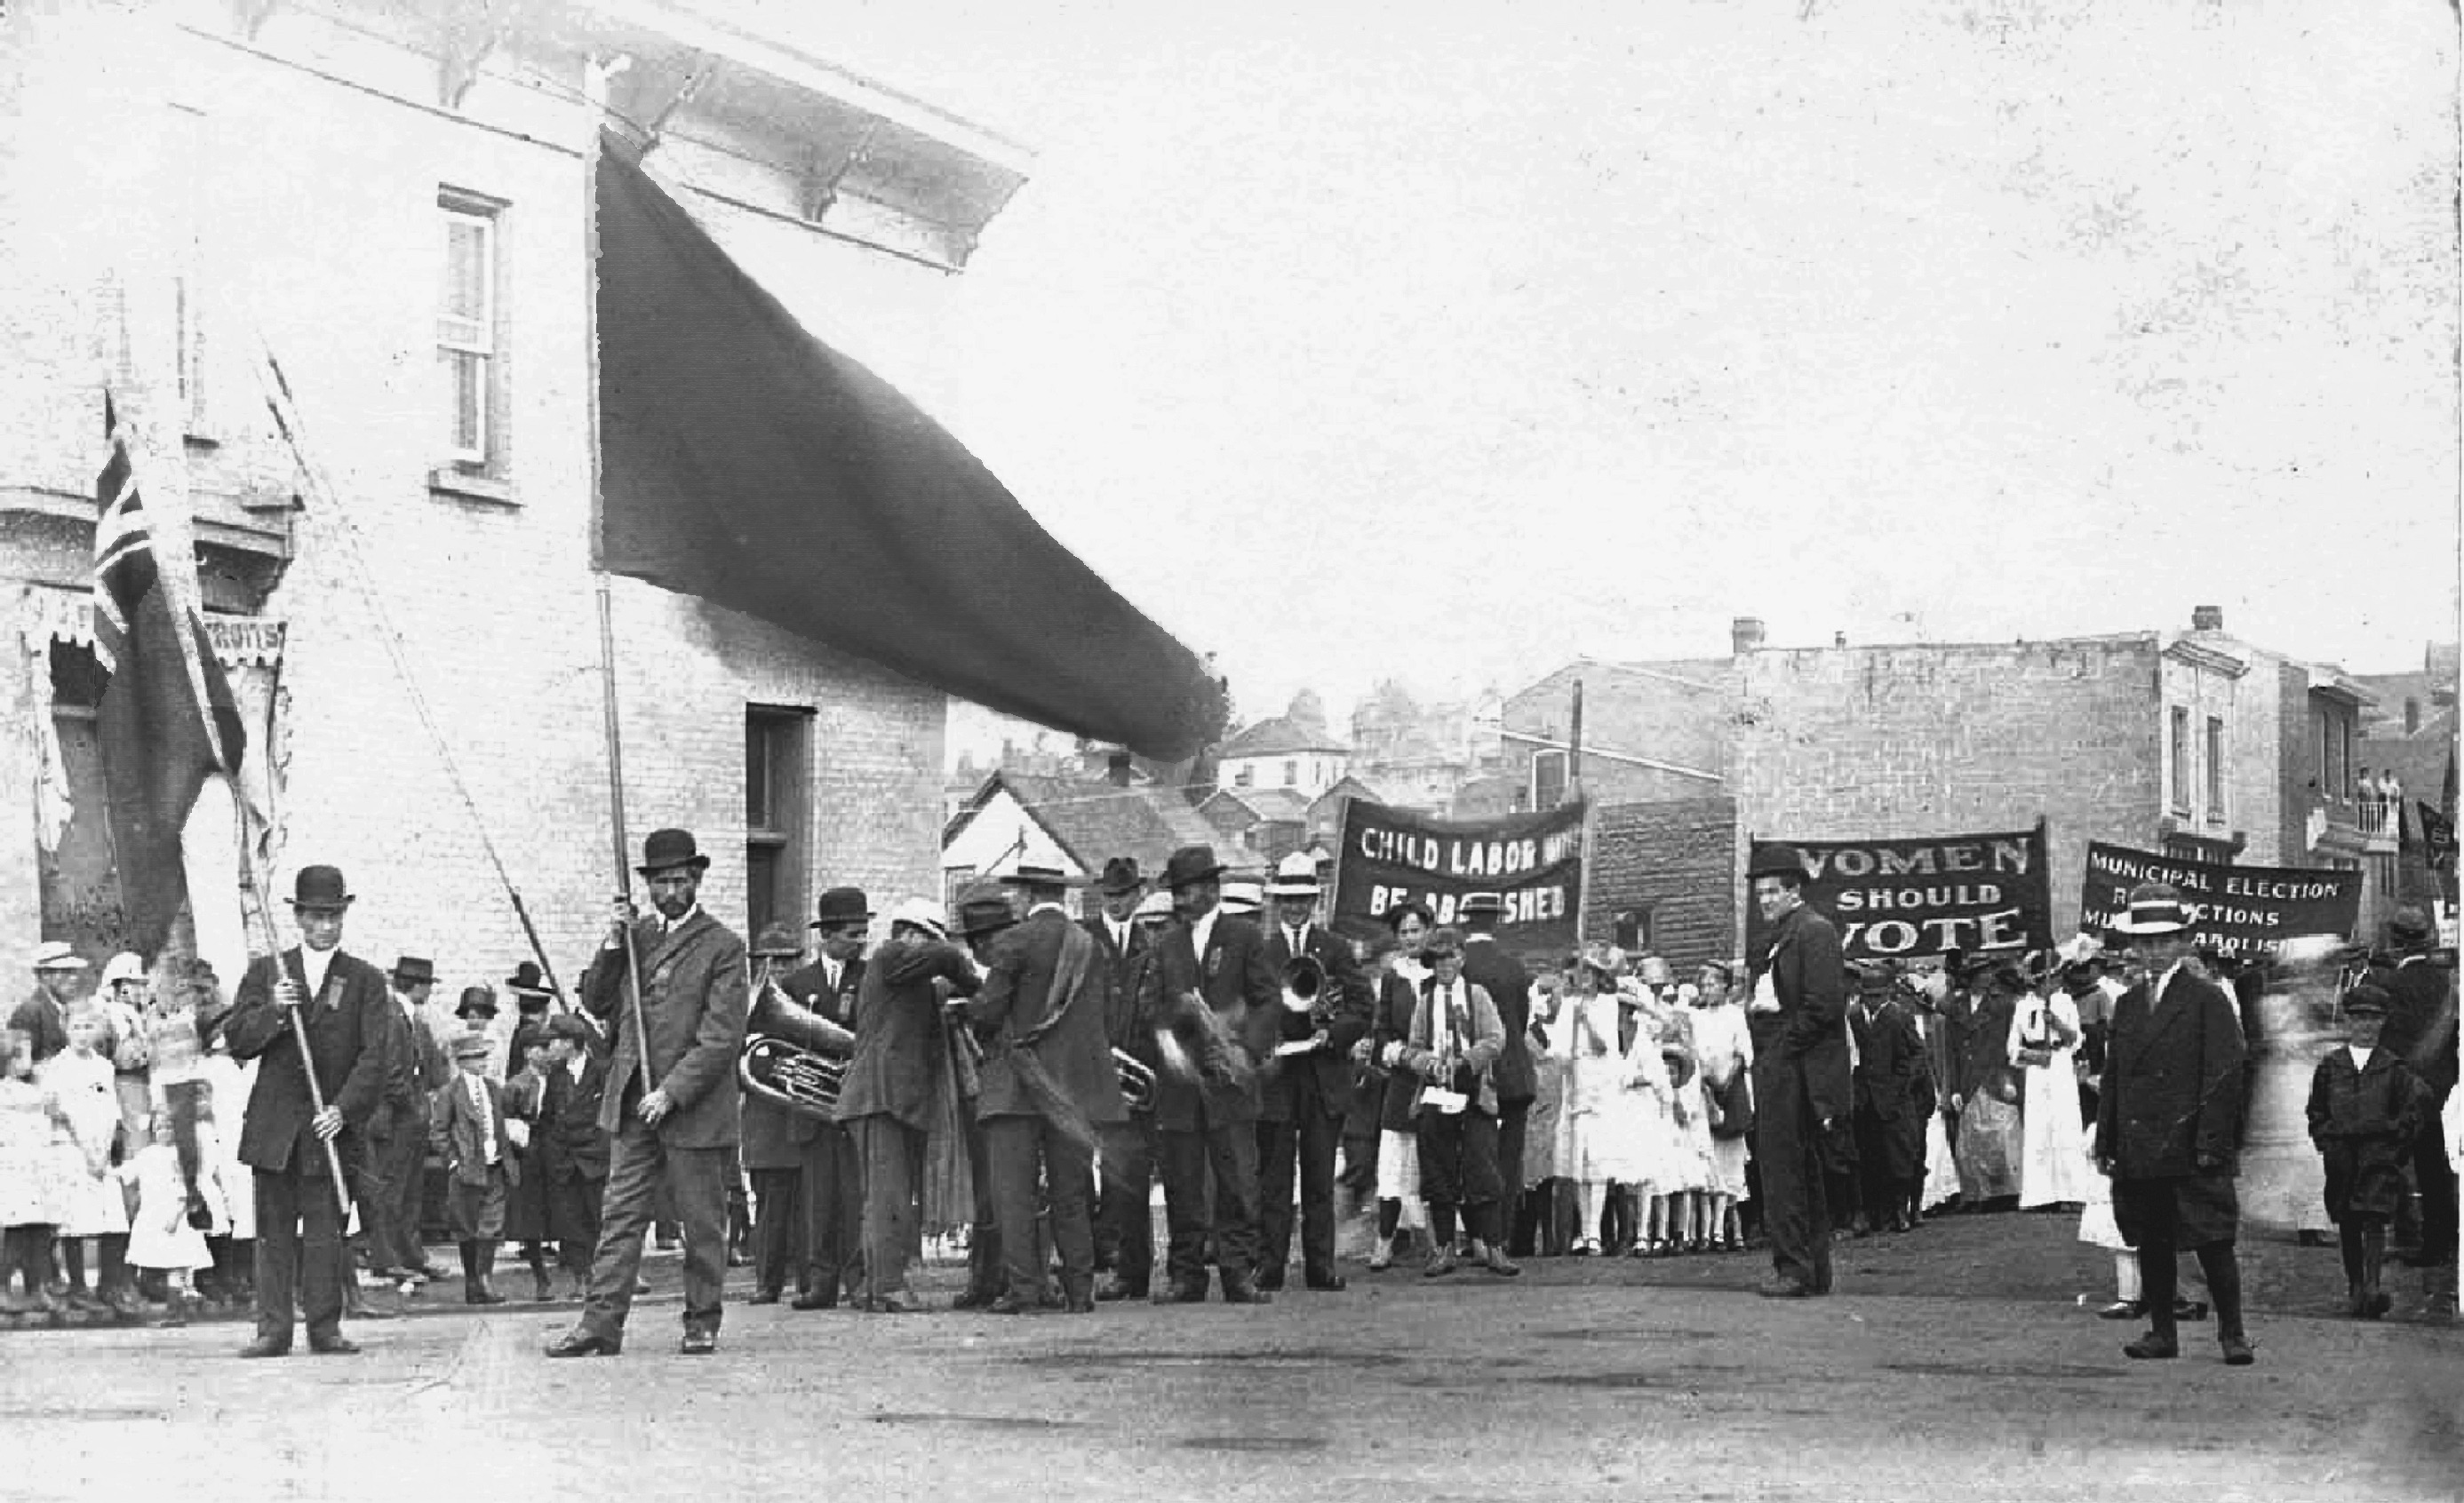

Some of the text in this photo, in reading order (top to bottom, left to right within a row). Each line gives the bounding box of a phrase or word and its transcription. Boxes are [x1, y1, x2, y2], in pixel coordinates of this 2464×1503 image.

[204, 622, 278, 649] RUITS
[1361, 827, 1438, 870] CHILD
[1451, 839, 1536, 876] LABOR
[2091, 850, 2340, 900] MUNICIPAL ELECTION
[1370, 885, 1565, 925] BE ABOSHED
[1837, 885, 2001, 911] SHOULD
